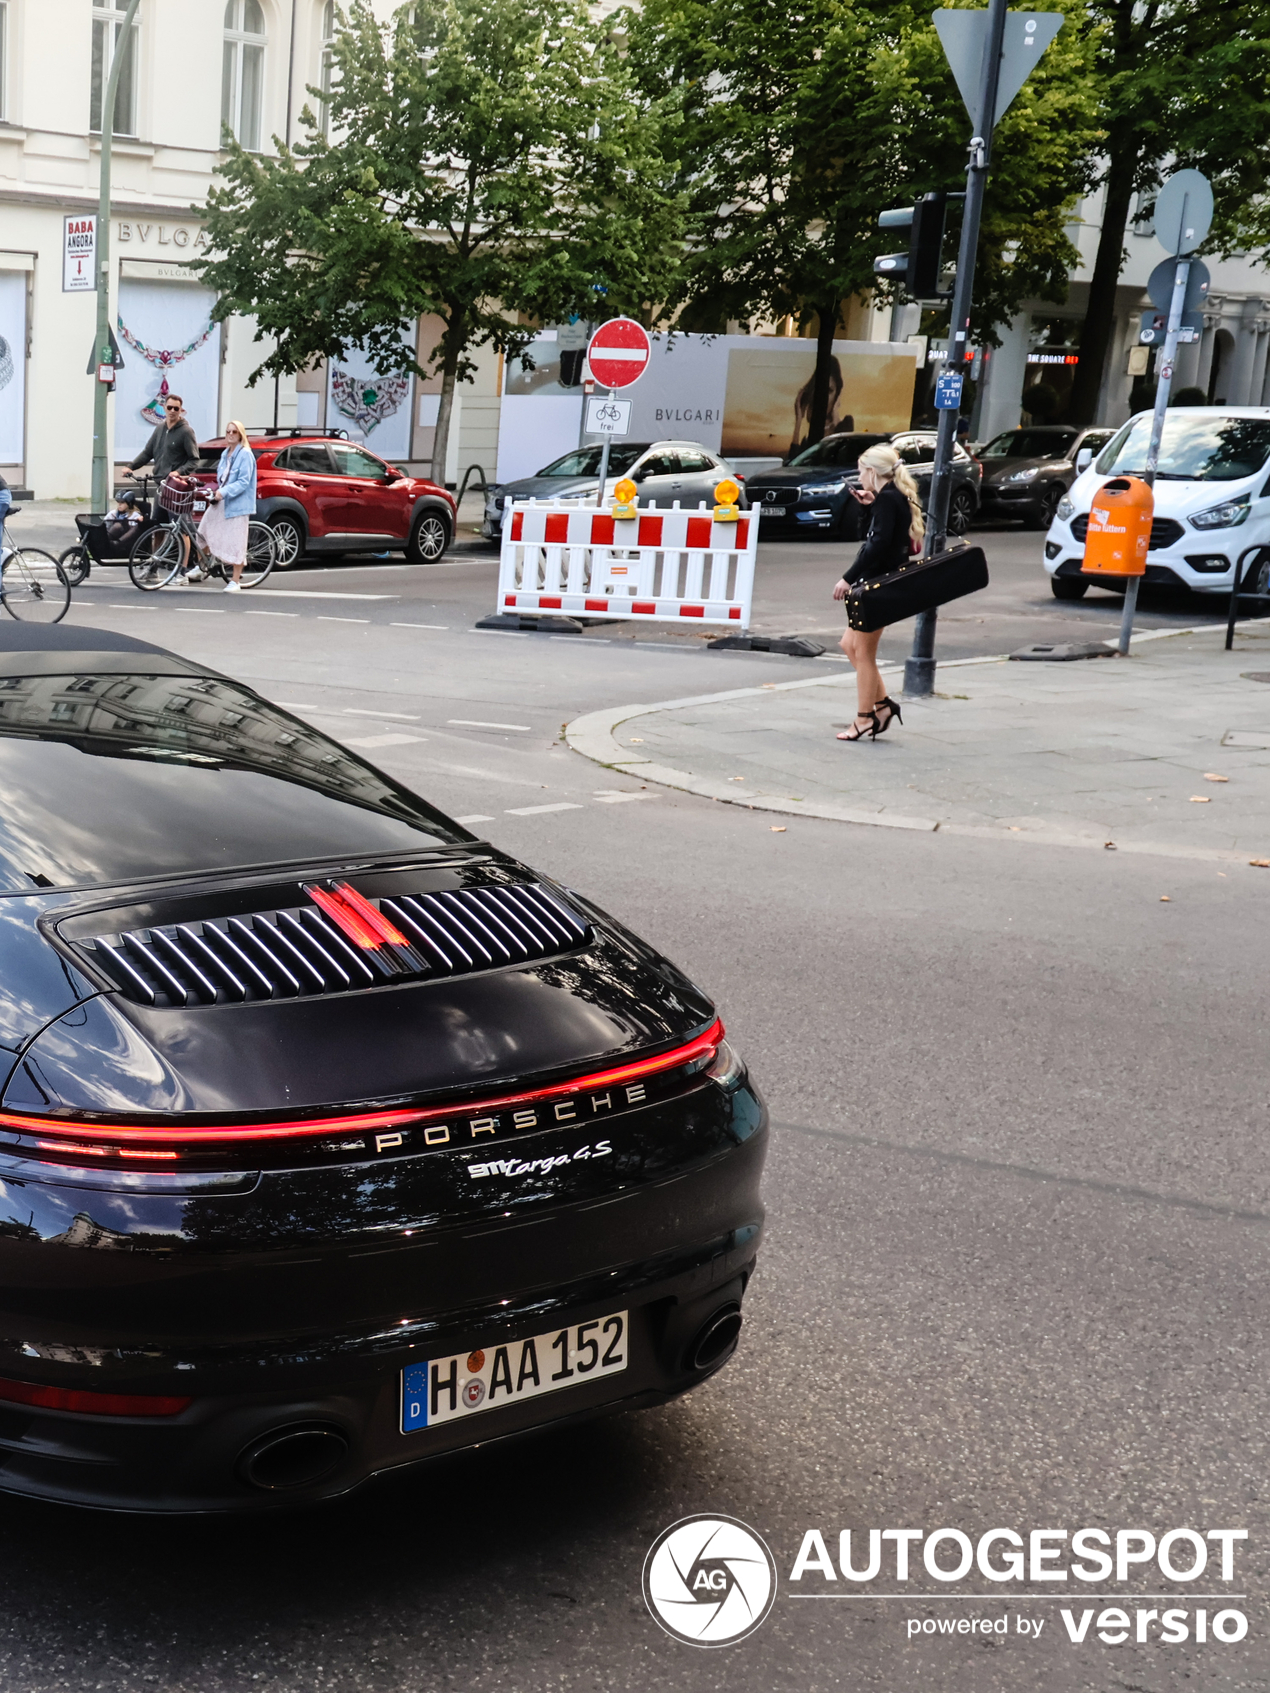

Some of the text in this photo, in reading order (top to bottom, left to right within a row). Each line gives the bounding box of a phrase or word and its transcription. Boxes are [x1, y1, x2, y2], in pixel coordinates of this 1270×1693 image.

[68, 221, 94, 235] BABA
[118, 222, 209, 247] BVLGA
[68, 234, 94, 248] ANGORA
[157, 268, 199, 278] BVLGARI
[655, 408, 720, 421] BVLGARI
[600, 422, 614, 431] frei
[375, 1083, 647, 1153] PORSCHE
[431, 1316, 624, 1416] H AA 152
